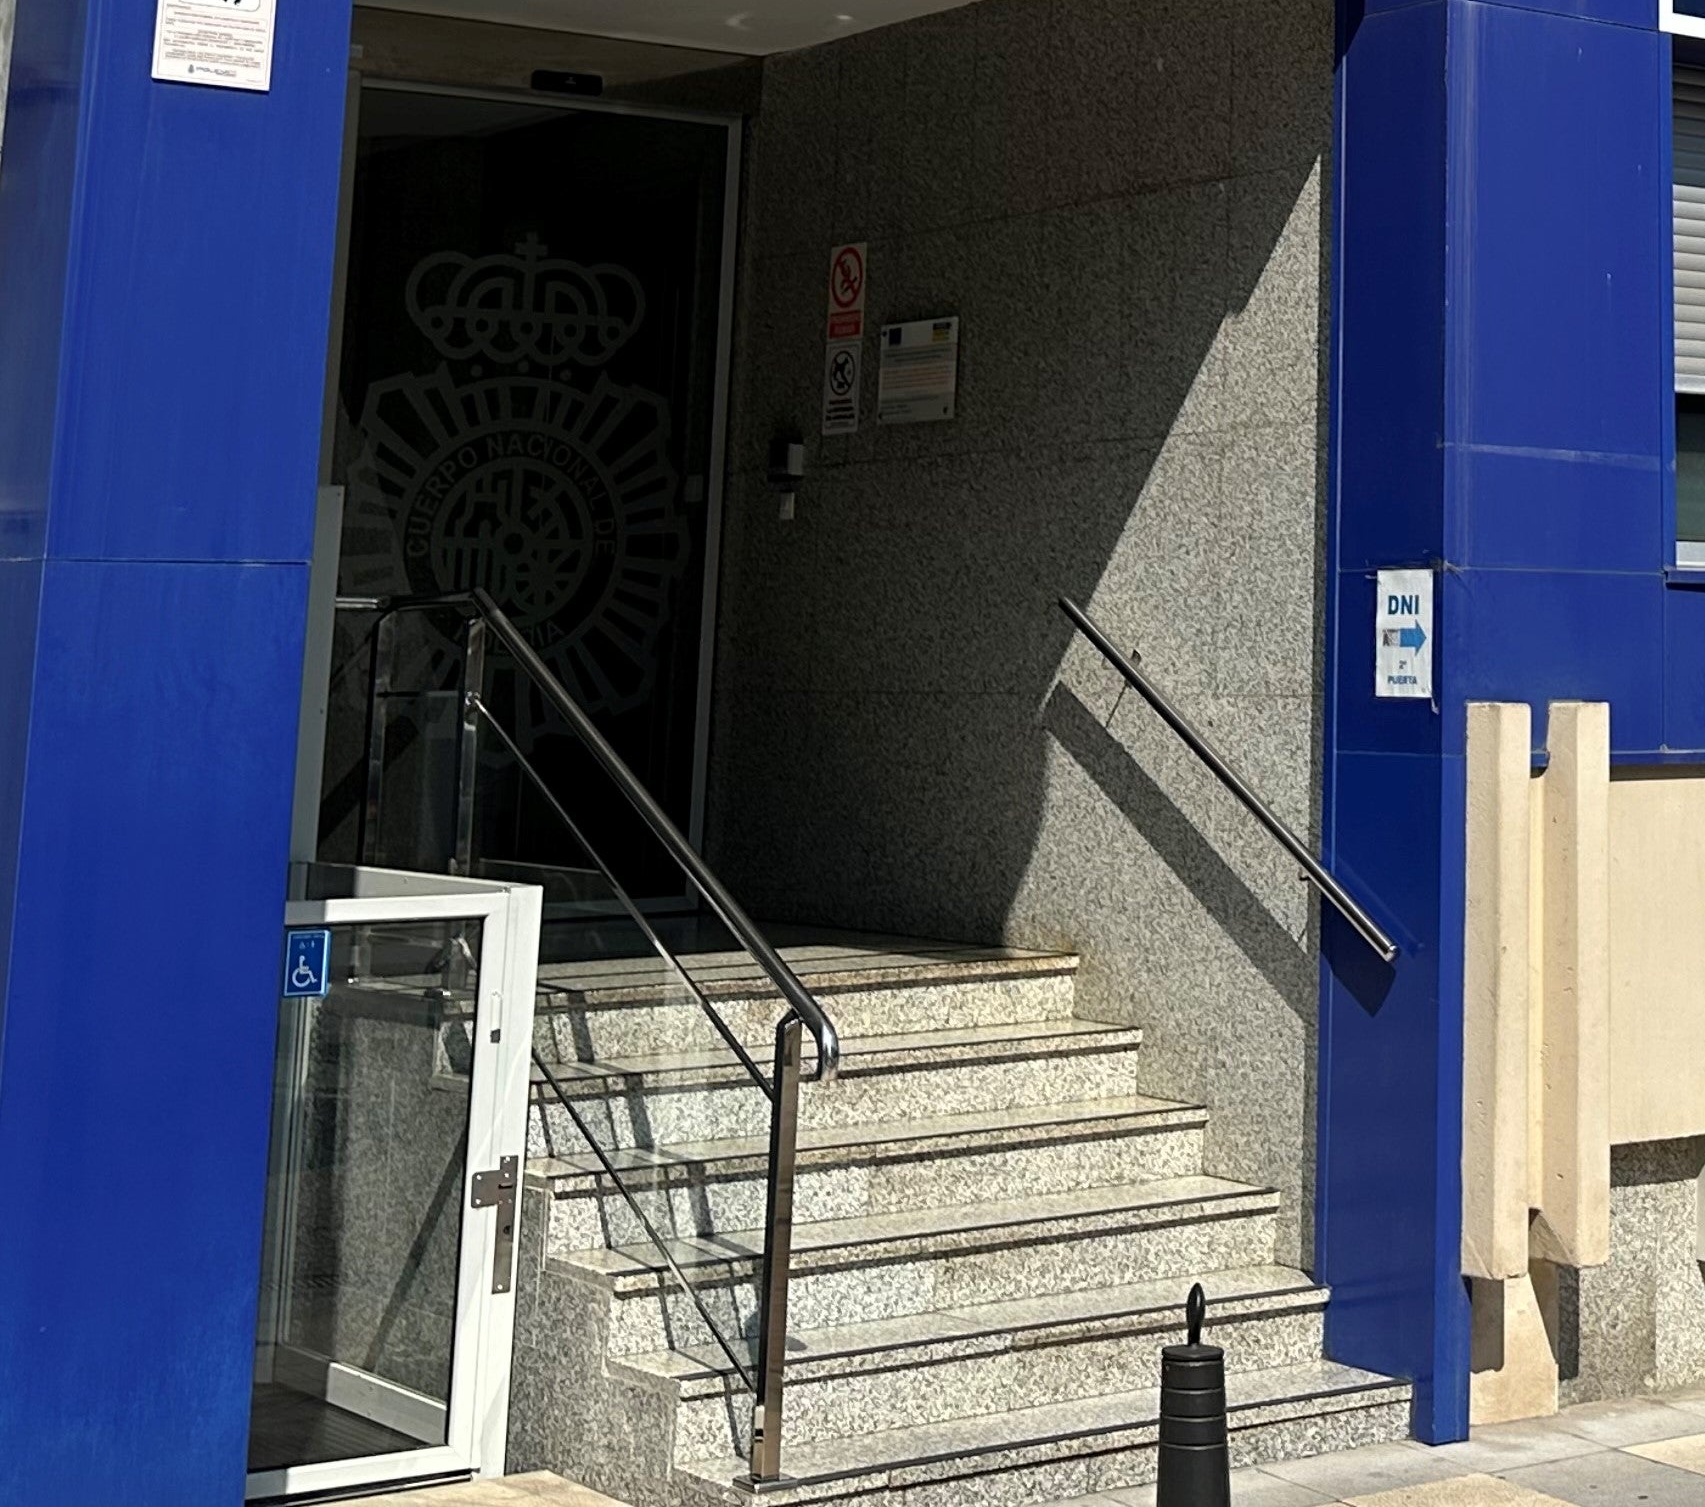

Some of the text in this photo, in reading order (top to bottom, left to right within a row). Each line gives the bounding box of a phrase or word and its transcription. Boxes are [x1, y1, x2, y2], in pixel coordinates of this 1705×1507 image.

[405, 433, 616, 558] CUERPO NACIONAL DE
[1387, 594, 1420, 615] DNI
